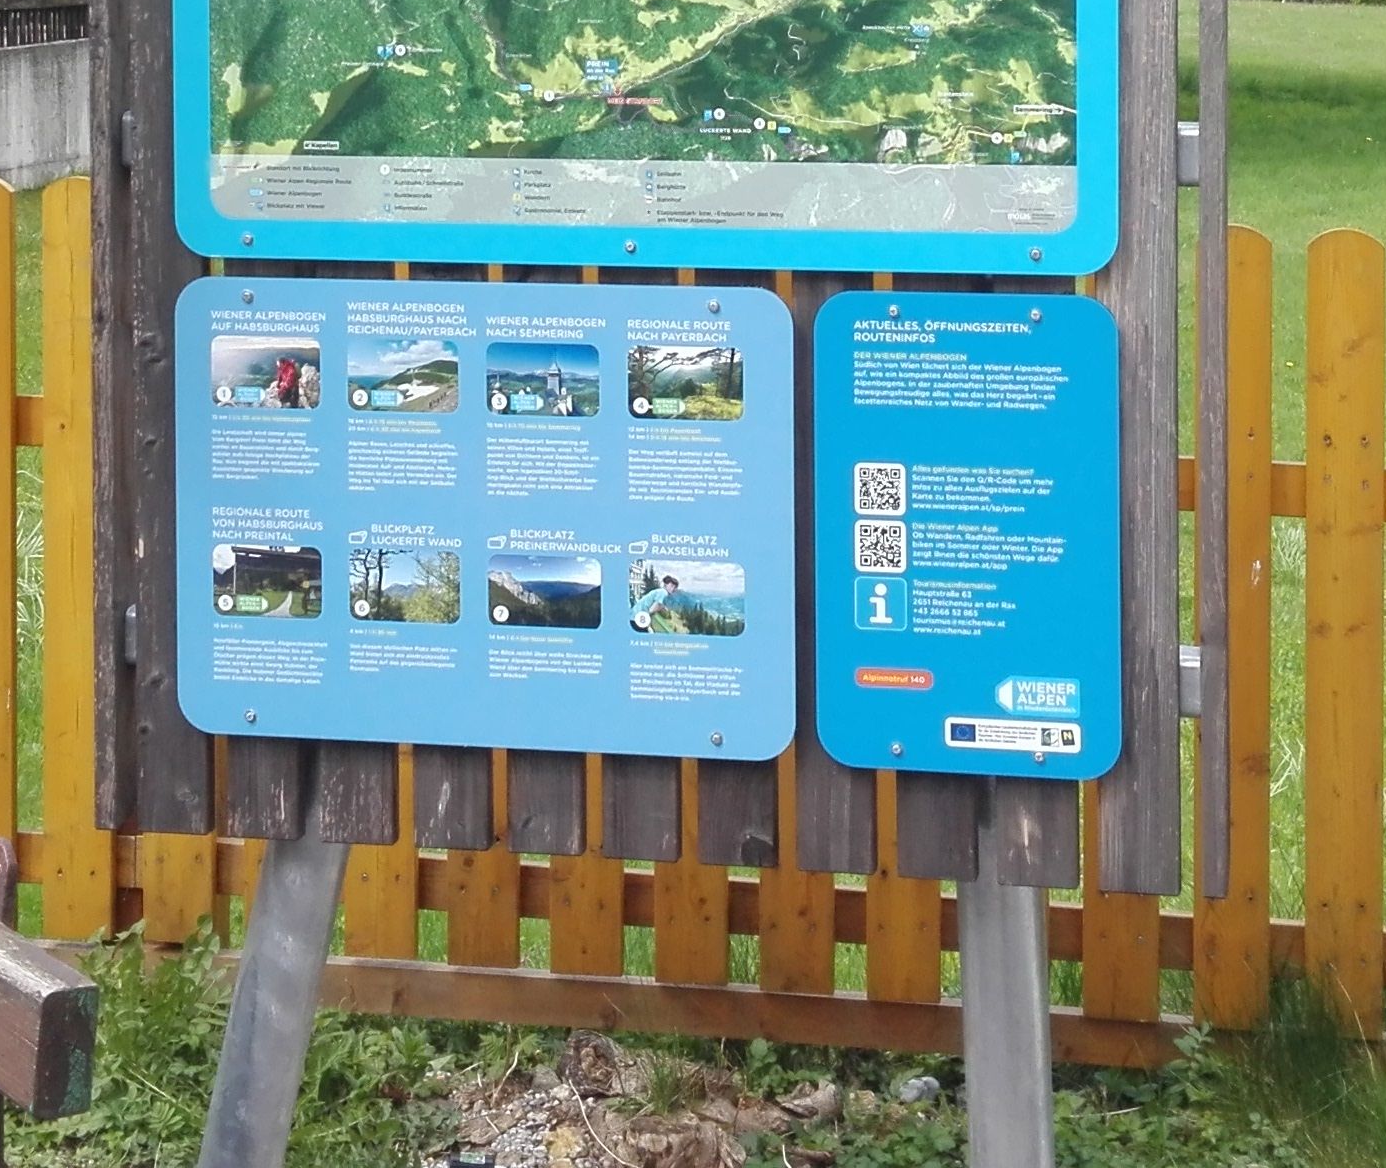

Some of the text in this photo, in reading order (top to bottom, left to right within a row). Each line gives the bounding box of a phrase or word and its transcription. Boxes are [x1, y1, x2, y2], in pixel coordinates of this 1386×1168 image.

[347, 302, 464, 313] WIENER ALPENBOGEN
[211, 311, 325, 322] WIENER ALPENBOGEN
[347, 314, 466, 325] HABSBURGHAUS NACH
[211, 322, 319, 332] AUF HABSBURGHAUS
[486, 317, 606, 328] WIENER ALPENBOGEN
[627, 320, 730, 330] REGIONALE ROUTE
[853, 321, 1030, 335] AKTUELLES, ÖFFNUNGSZEITEN,
[347, 325, 476, 339] REICHENAU/PAYERBACH
[486, 328, 583, 339] NACH SEMMERING
[627, 331, 726, 342] NACH PAYERBACH
[853, 333, 935, 343] ROUTENINFOS
[212, 507, 309, 518] REGIONALE ROUTE
[212, 519, 323, 531] VON HABSBURGHAUS
[371, 524, 434, 535] BLICKPLATZ
[212, 530, 293, 541] NACH PREINTAL
[510, 529, 574, 540] BLICKPLATZ
[652, 534, 717, 545] BLICKPLATZ
[371, 535, 461, 548] LUCKERTE WAND
[510, 541, 621, 553] PREINERWANDBLICK
[651, 547, 728, 557] RAXSEILBAHN
[1017, 681, 1076, 695] WIENER
[1017, 694, 1066, 706] ALPEN
